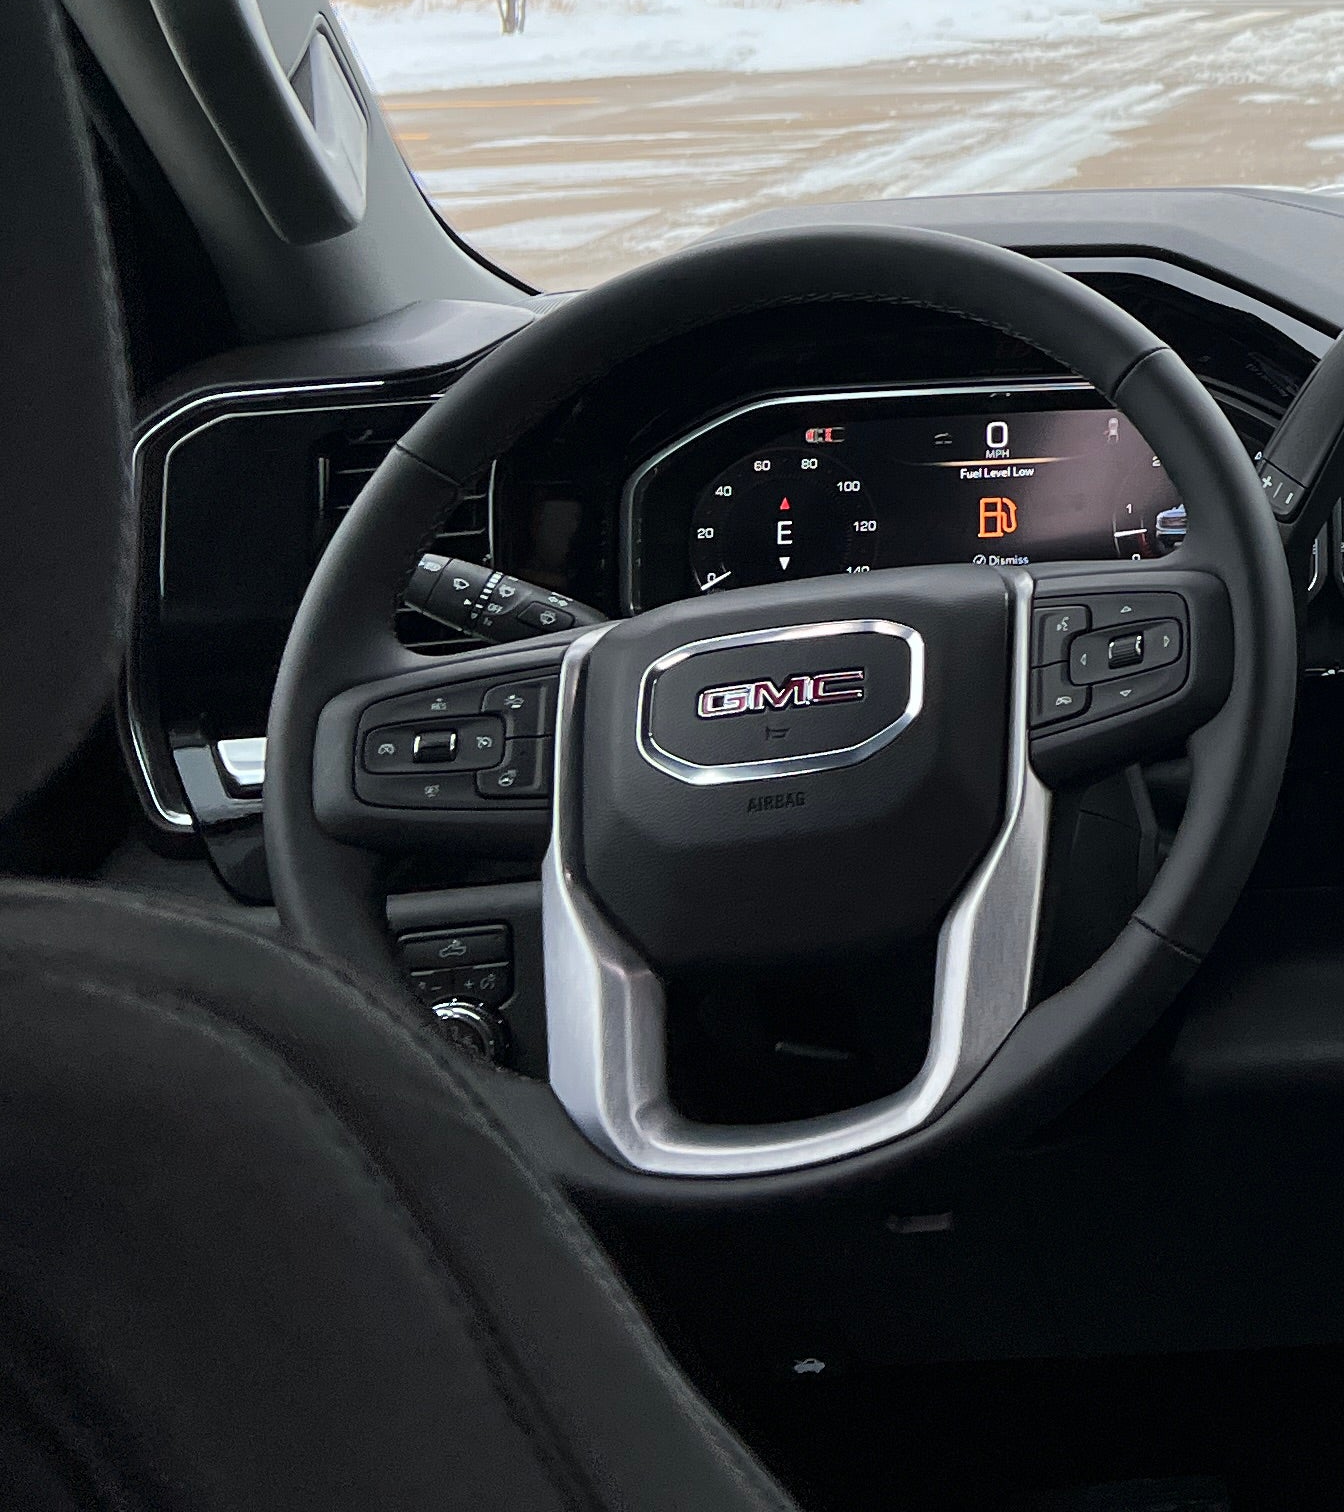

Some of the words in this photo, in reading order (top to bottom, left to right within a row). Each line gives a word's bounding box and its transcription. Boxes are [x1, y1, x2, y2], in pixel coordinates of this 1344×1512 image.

[986, 421, 1009, 449] 0
[985, 449, 1009, 459] MPH
[753, 460, 771, 472] 60
[801, 458, 818, 470] 80
[960, 467, 983, 479] Fuel
[984, 466, 1011, 479] Level
[1013, 465, 1035, 478] Low
[715, 485, 732, 497] 40
[837, 480, 860, 492] 100
[777, 520, 793, 545] E
[853, 520, 876, 533] 120
[697, 528, 714, 540] 20
[988, 553, 1029, 566] Dismiss
[697, 669, 864, 719] GMC
[746, 792, 807, 815] AIRBAG
